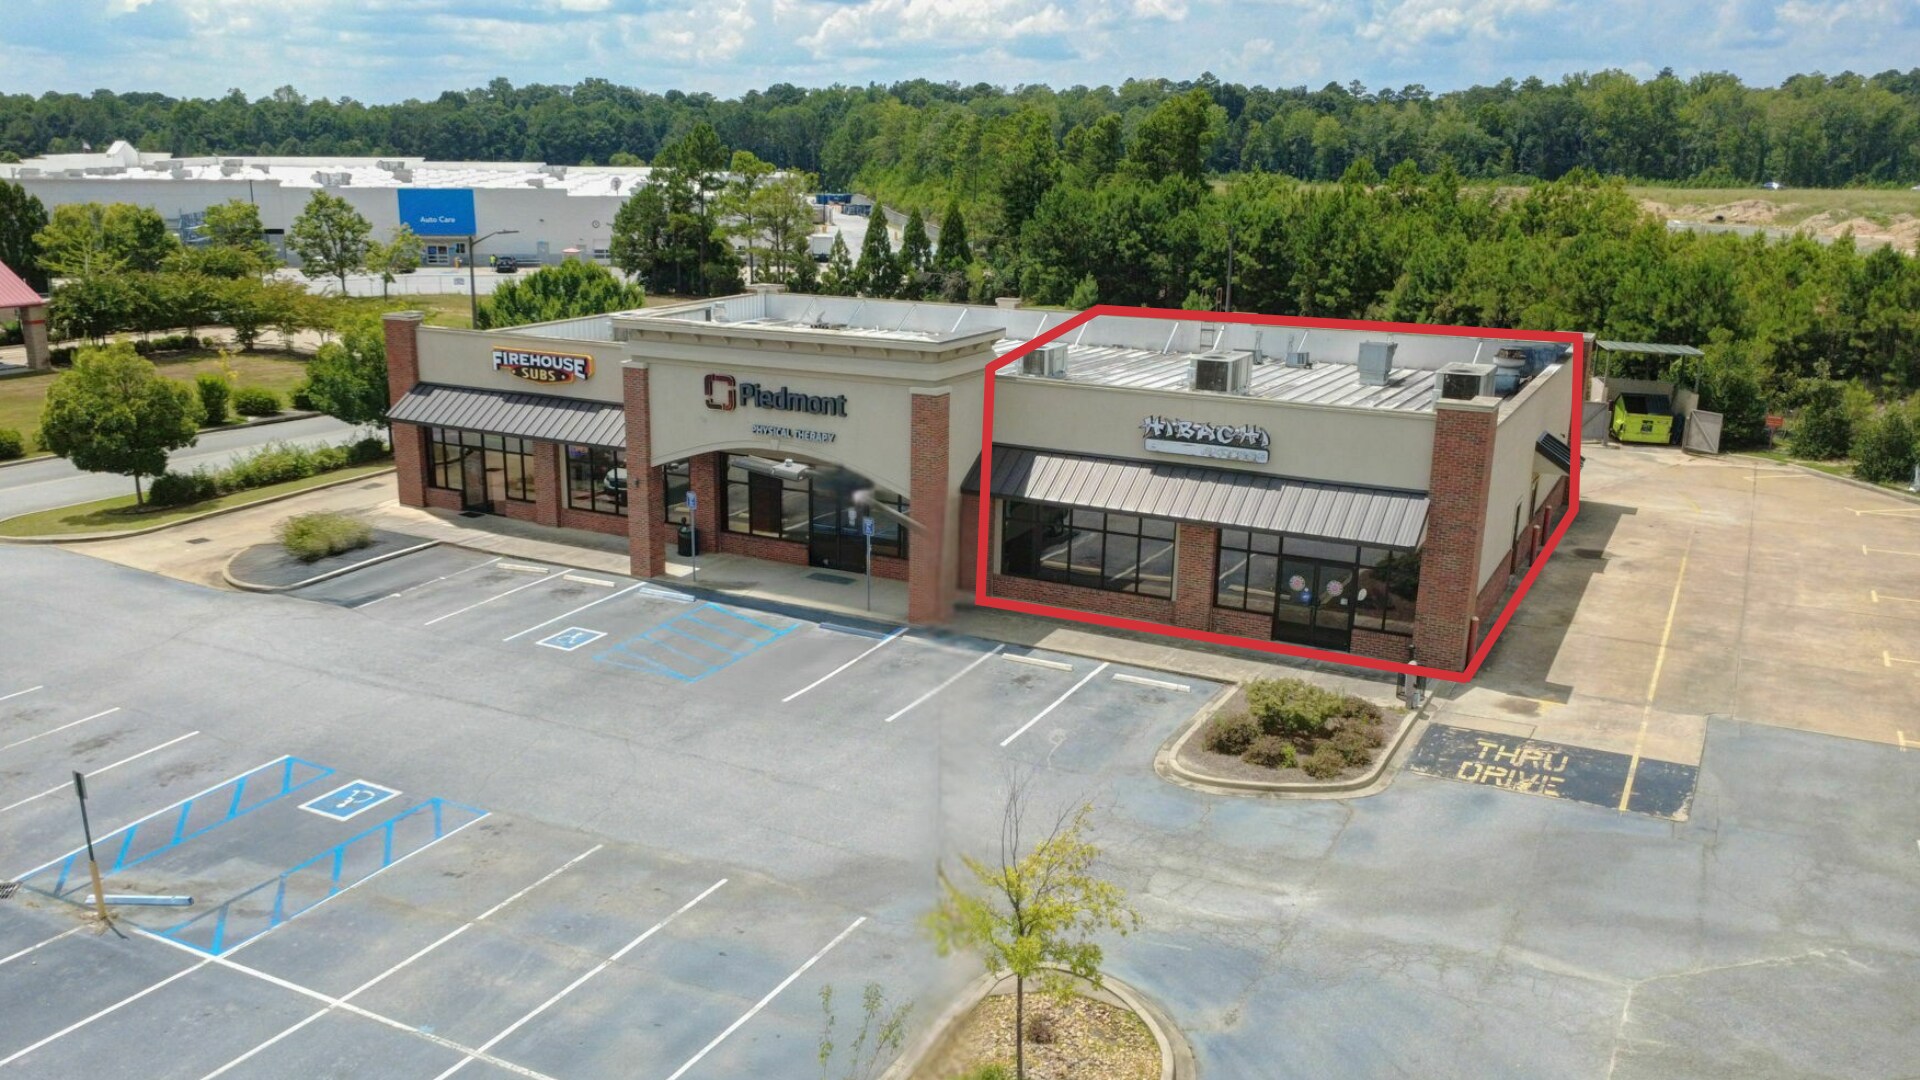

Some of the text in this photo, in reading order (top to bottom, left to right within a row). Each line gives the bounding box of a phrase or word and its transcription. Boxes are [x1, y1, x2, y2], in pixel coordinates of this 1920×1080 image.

[492, 351, 586, 380] FIREHOUSE
[521, 367, 556, 381] SUBS
[739, 382, 848, 417] Piedmont
[752, 424, 836, 443] PHYSICAL THERAPY
[1142, 415, 1270, 447] HIBACHI
[1477, 741, 1569, 772] THRU
[1457, 761, 1566, 797] DRIVE
